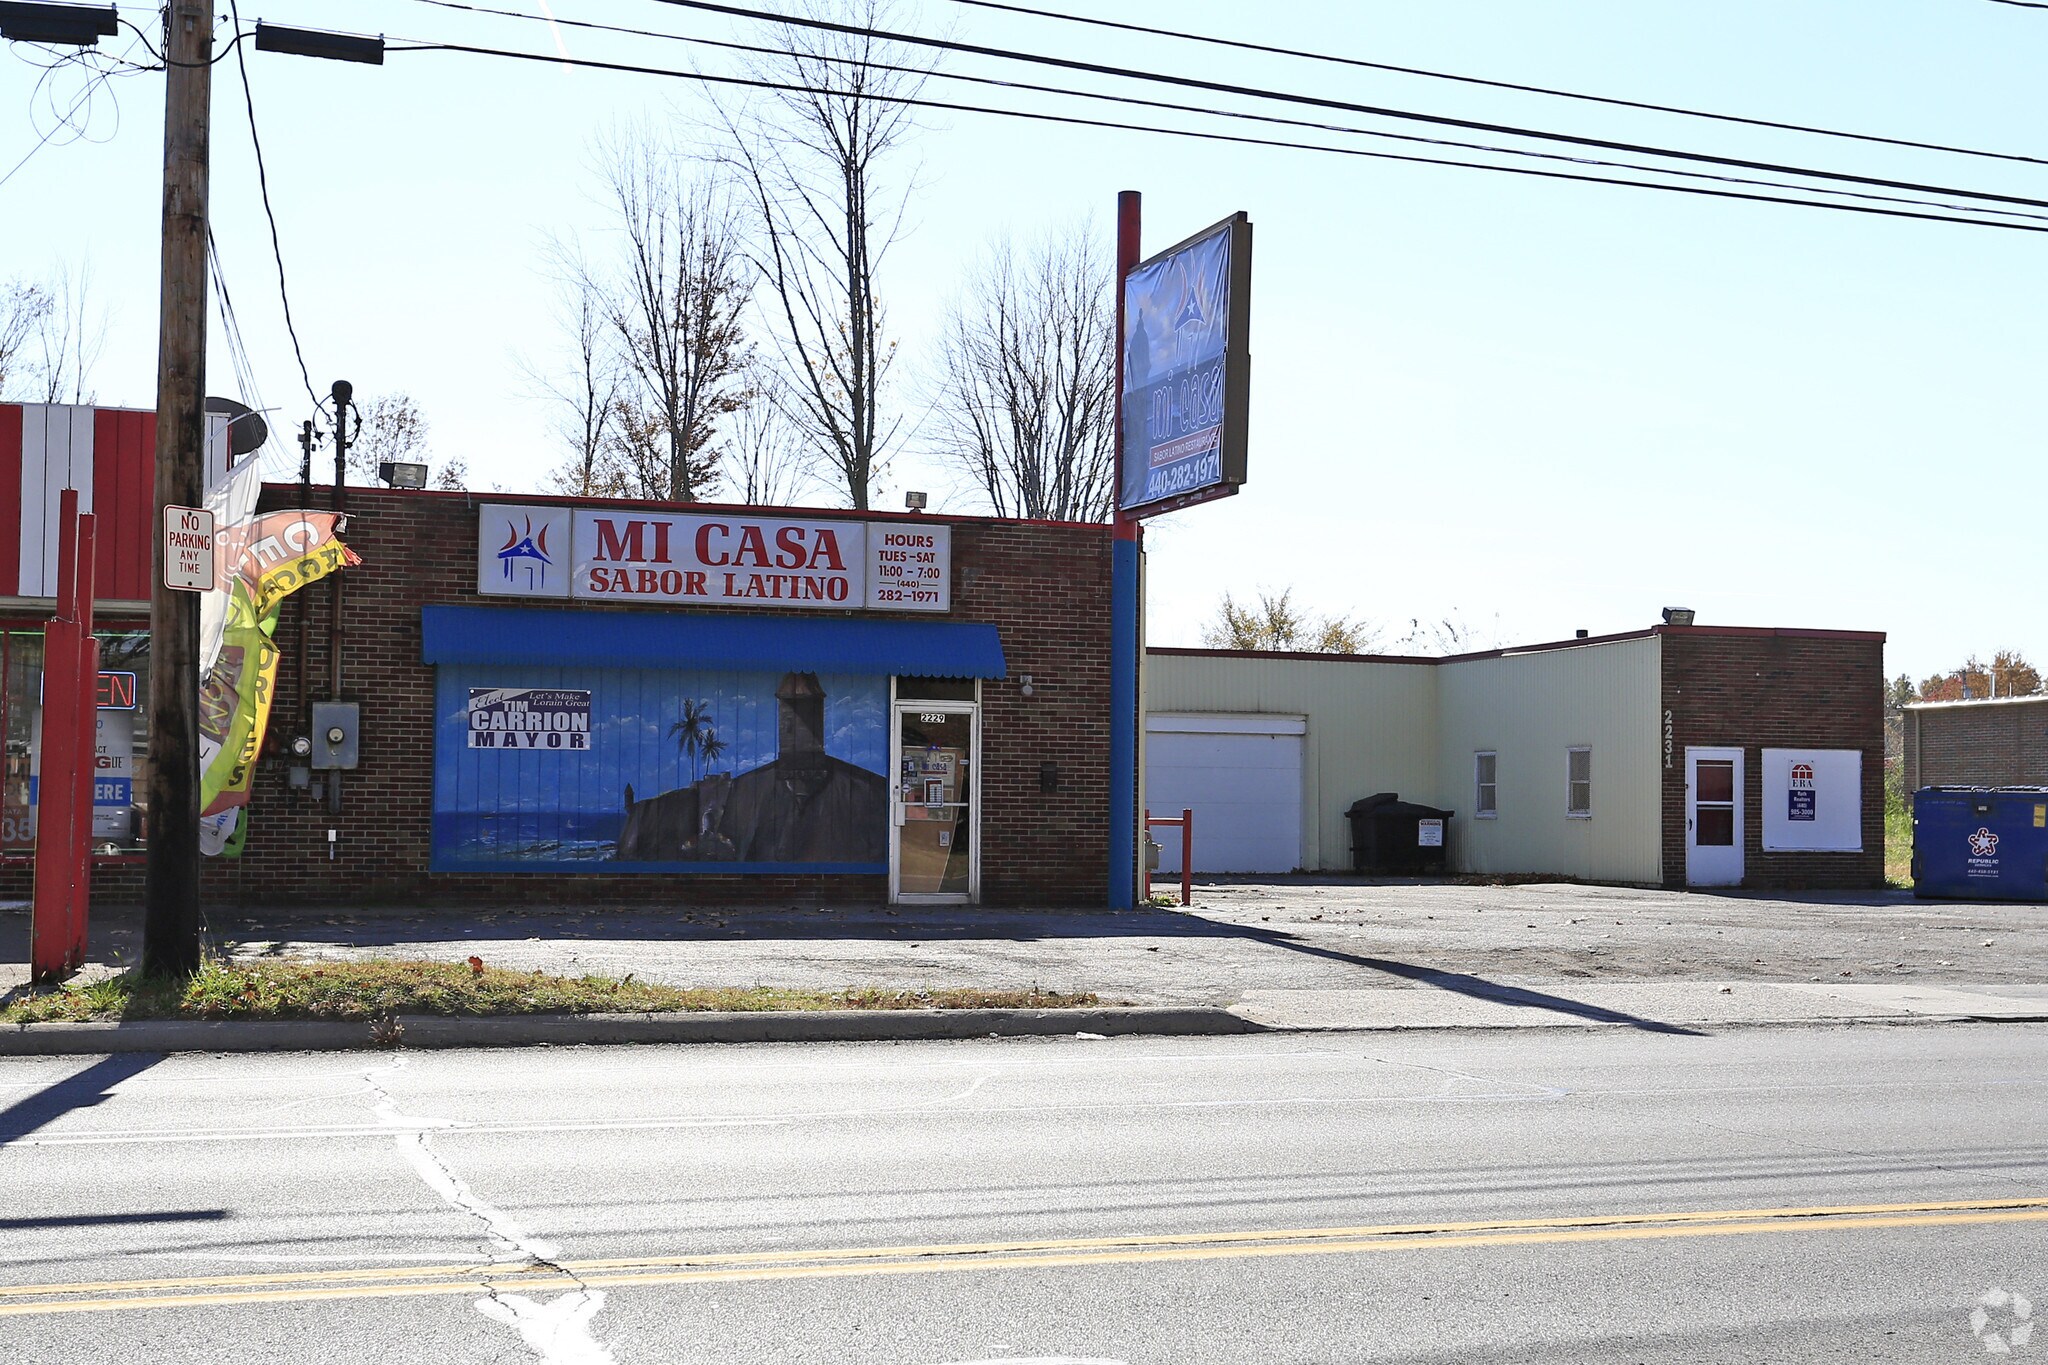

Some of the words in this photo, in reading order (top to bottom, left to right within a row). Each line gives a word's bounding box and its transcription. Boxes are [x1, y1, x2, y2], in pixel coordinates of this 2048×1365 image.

[1153, 448, 1169, 463] SABOR
[1168, 443, 1185, 458] LATINO
[1148, 454, 1220, 497] 440-282-1971
[181, 514, 200, 531] NO
[169, 531, 211, 551] PARKING
[592, 519, 673, 563] MI
[695, 523, 847, 571] CASA
[884, 533, 934, 548] HOURS
[180, 550, 200, 562] ANY
[878, 550, 907, 562] TUES
[179, 561, 201, 575] TIME
[878, 564, 903, 577] 11:00
[917, 567, 940, 579] 7:00
[589, 567, 708, 596] SABOR
[722, 572, 850, 601] LATINO
[896, 580, 920, 588] (440)
[877, 589, 939, 602] 282-1971
[97, 674, 134, 706] EN
[529, 692, 552, 700] Let's
[555, 692, 580, 700] Make
[502, 701, 529, 712] TIM
[471, 711, 588, 732] CARRION
[921, 713, 945, 723] 2229
[475, 732, 584, 748] MAYOR
[1664, 709, 1673, 769] 2231
[1792, 779, 1813, 787] ERA
[95, 784, 123, 800] ERE
